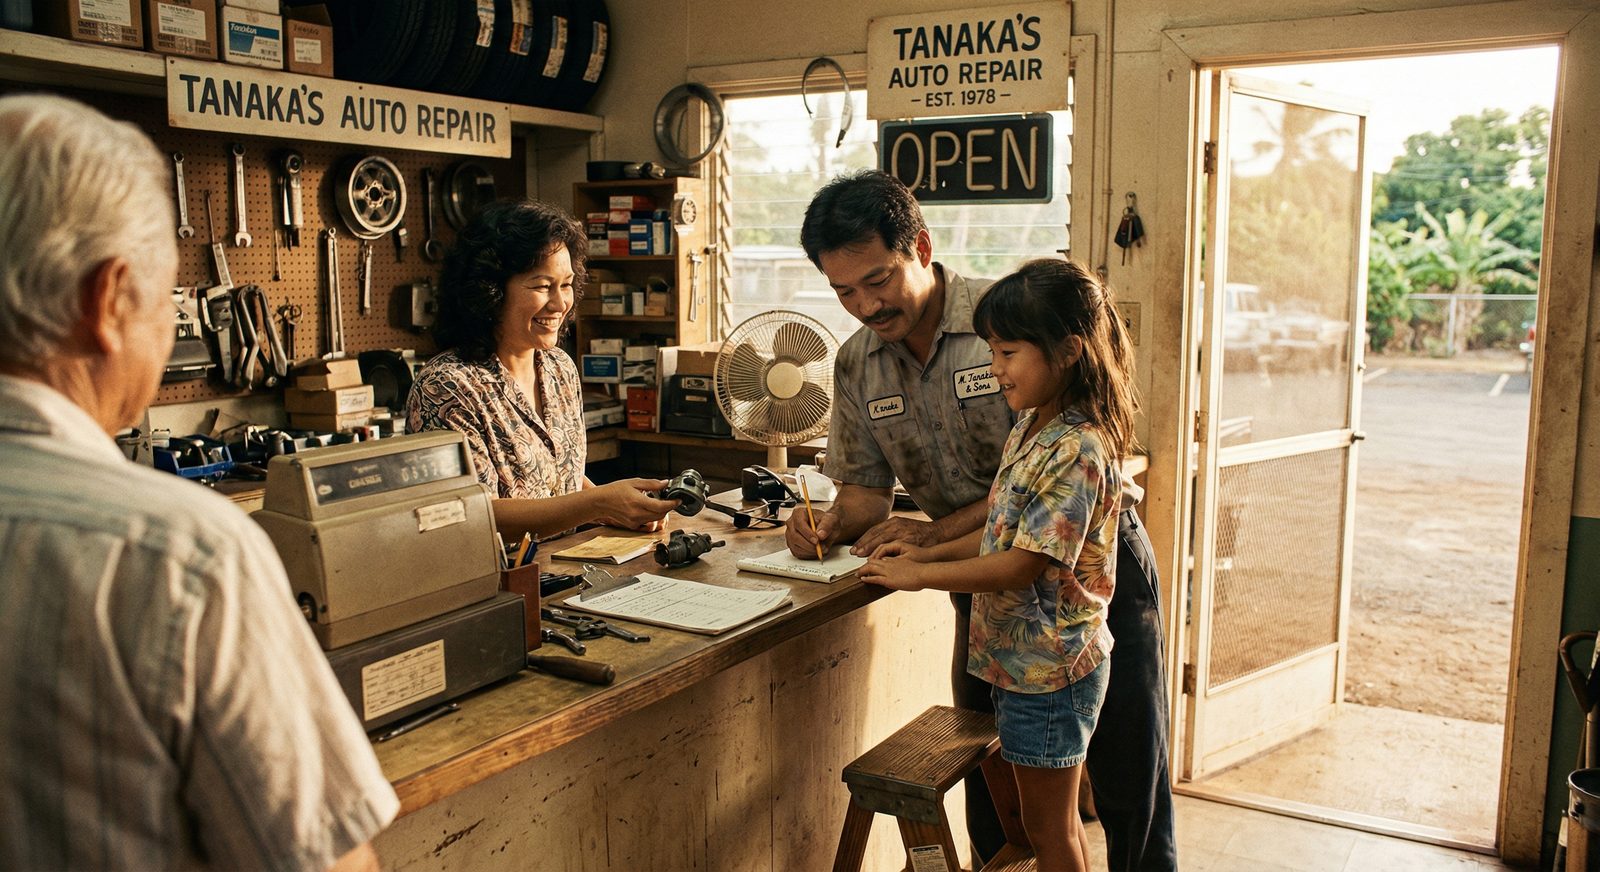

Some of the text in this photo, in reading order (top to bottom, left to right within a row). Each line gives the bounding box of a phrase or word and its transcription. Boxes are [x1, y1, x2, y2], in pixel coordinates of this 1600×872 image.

[893, 13, 1041, 60] TANAKA'S
[888, 58, 1042, 89] AUTO REPAIR
[179, 74, 496, 144] TANAKA'S AUTO REPAIR
[925, 89, 996, 107] EST. 1978
[891, 126, 1038, 193] OPEN
[965, 382, 991, 394] & Sons
